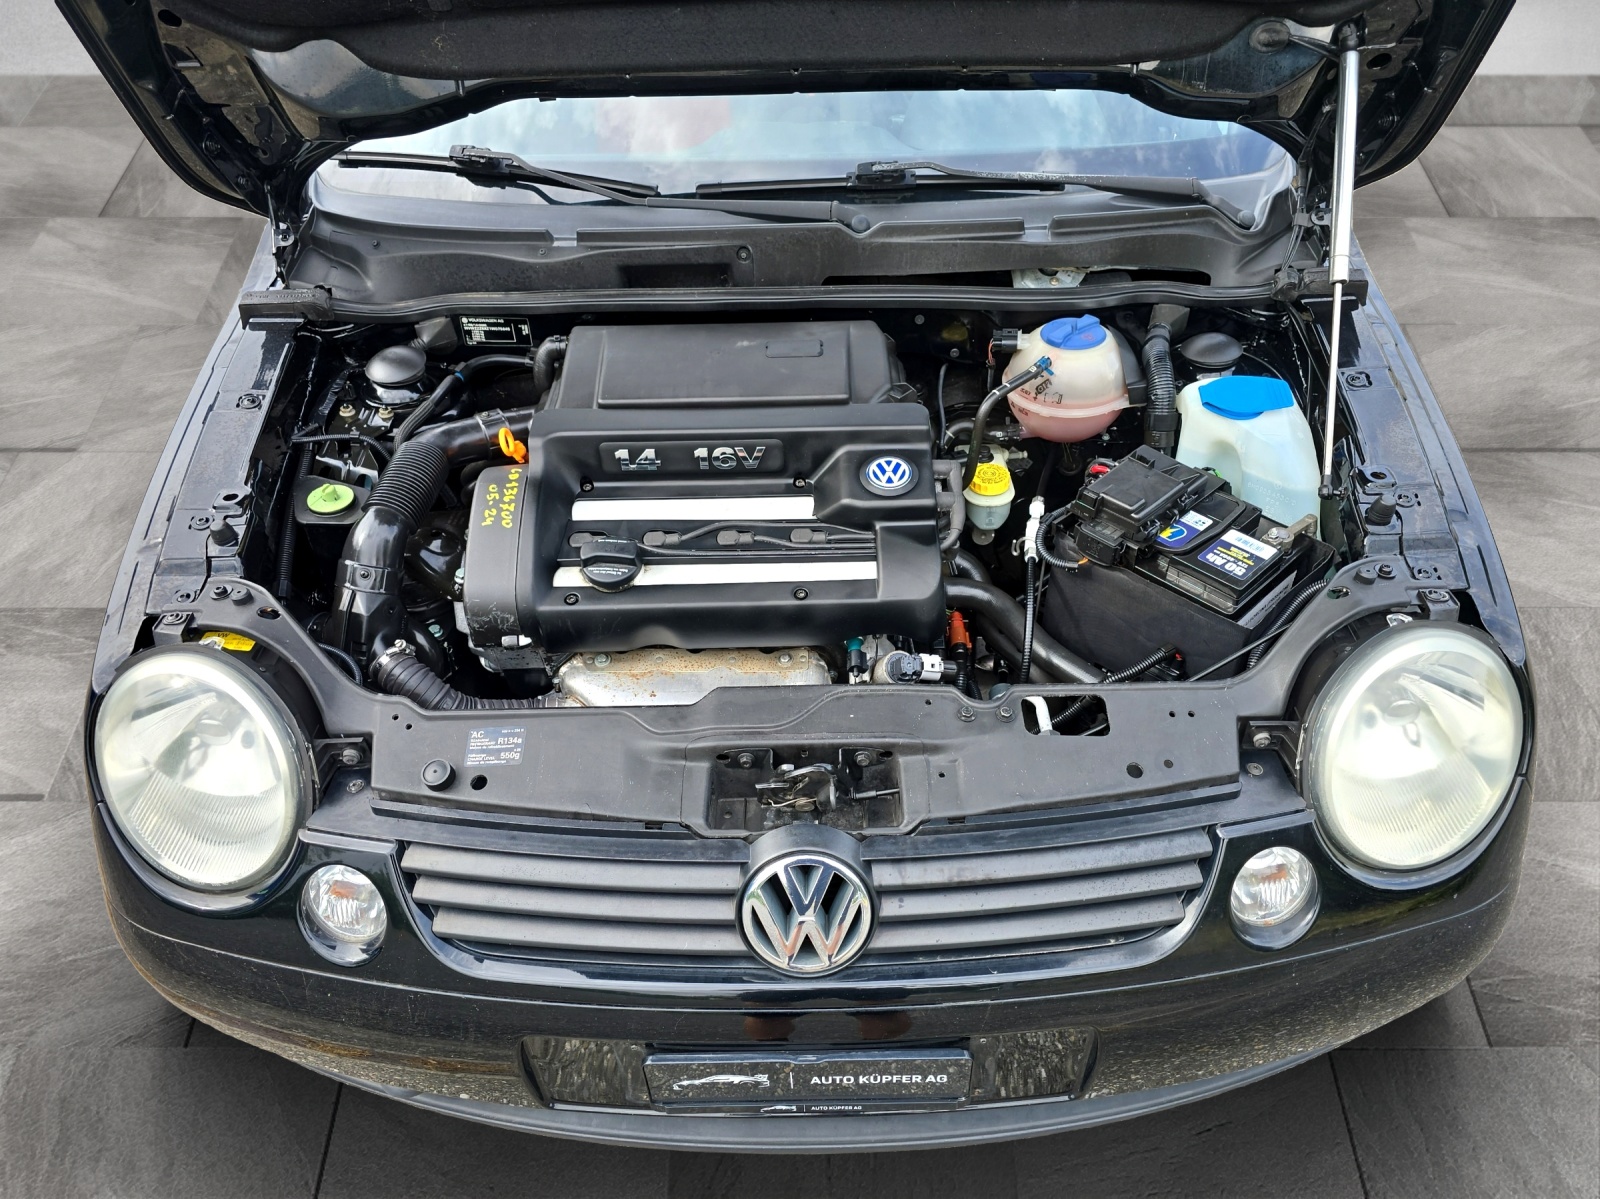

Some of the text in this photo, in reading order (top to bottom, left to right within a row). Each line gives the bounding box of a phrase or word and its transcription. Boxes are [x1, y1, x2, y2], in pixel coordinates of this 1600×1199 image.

[693, 446, 766, 470] 16V
[1205, 552, 1226, 566] Ah
[1225, 562, 1247, 576] 50
[470, 730, 485, 739] AC
[500, 752, 520, 760] 550g
[810, 1073, 949, 1085] AUTO KÜPFER AG
